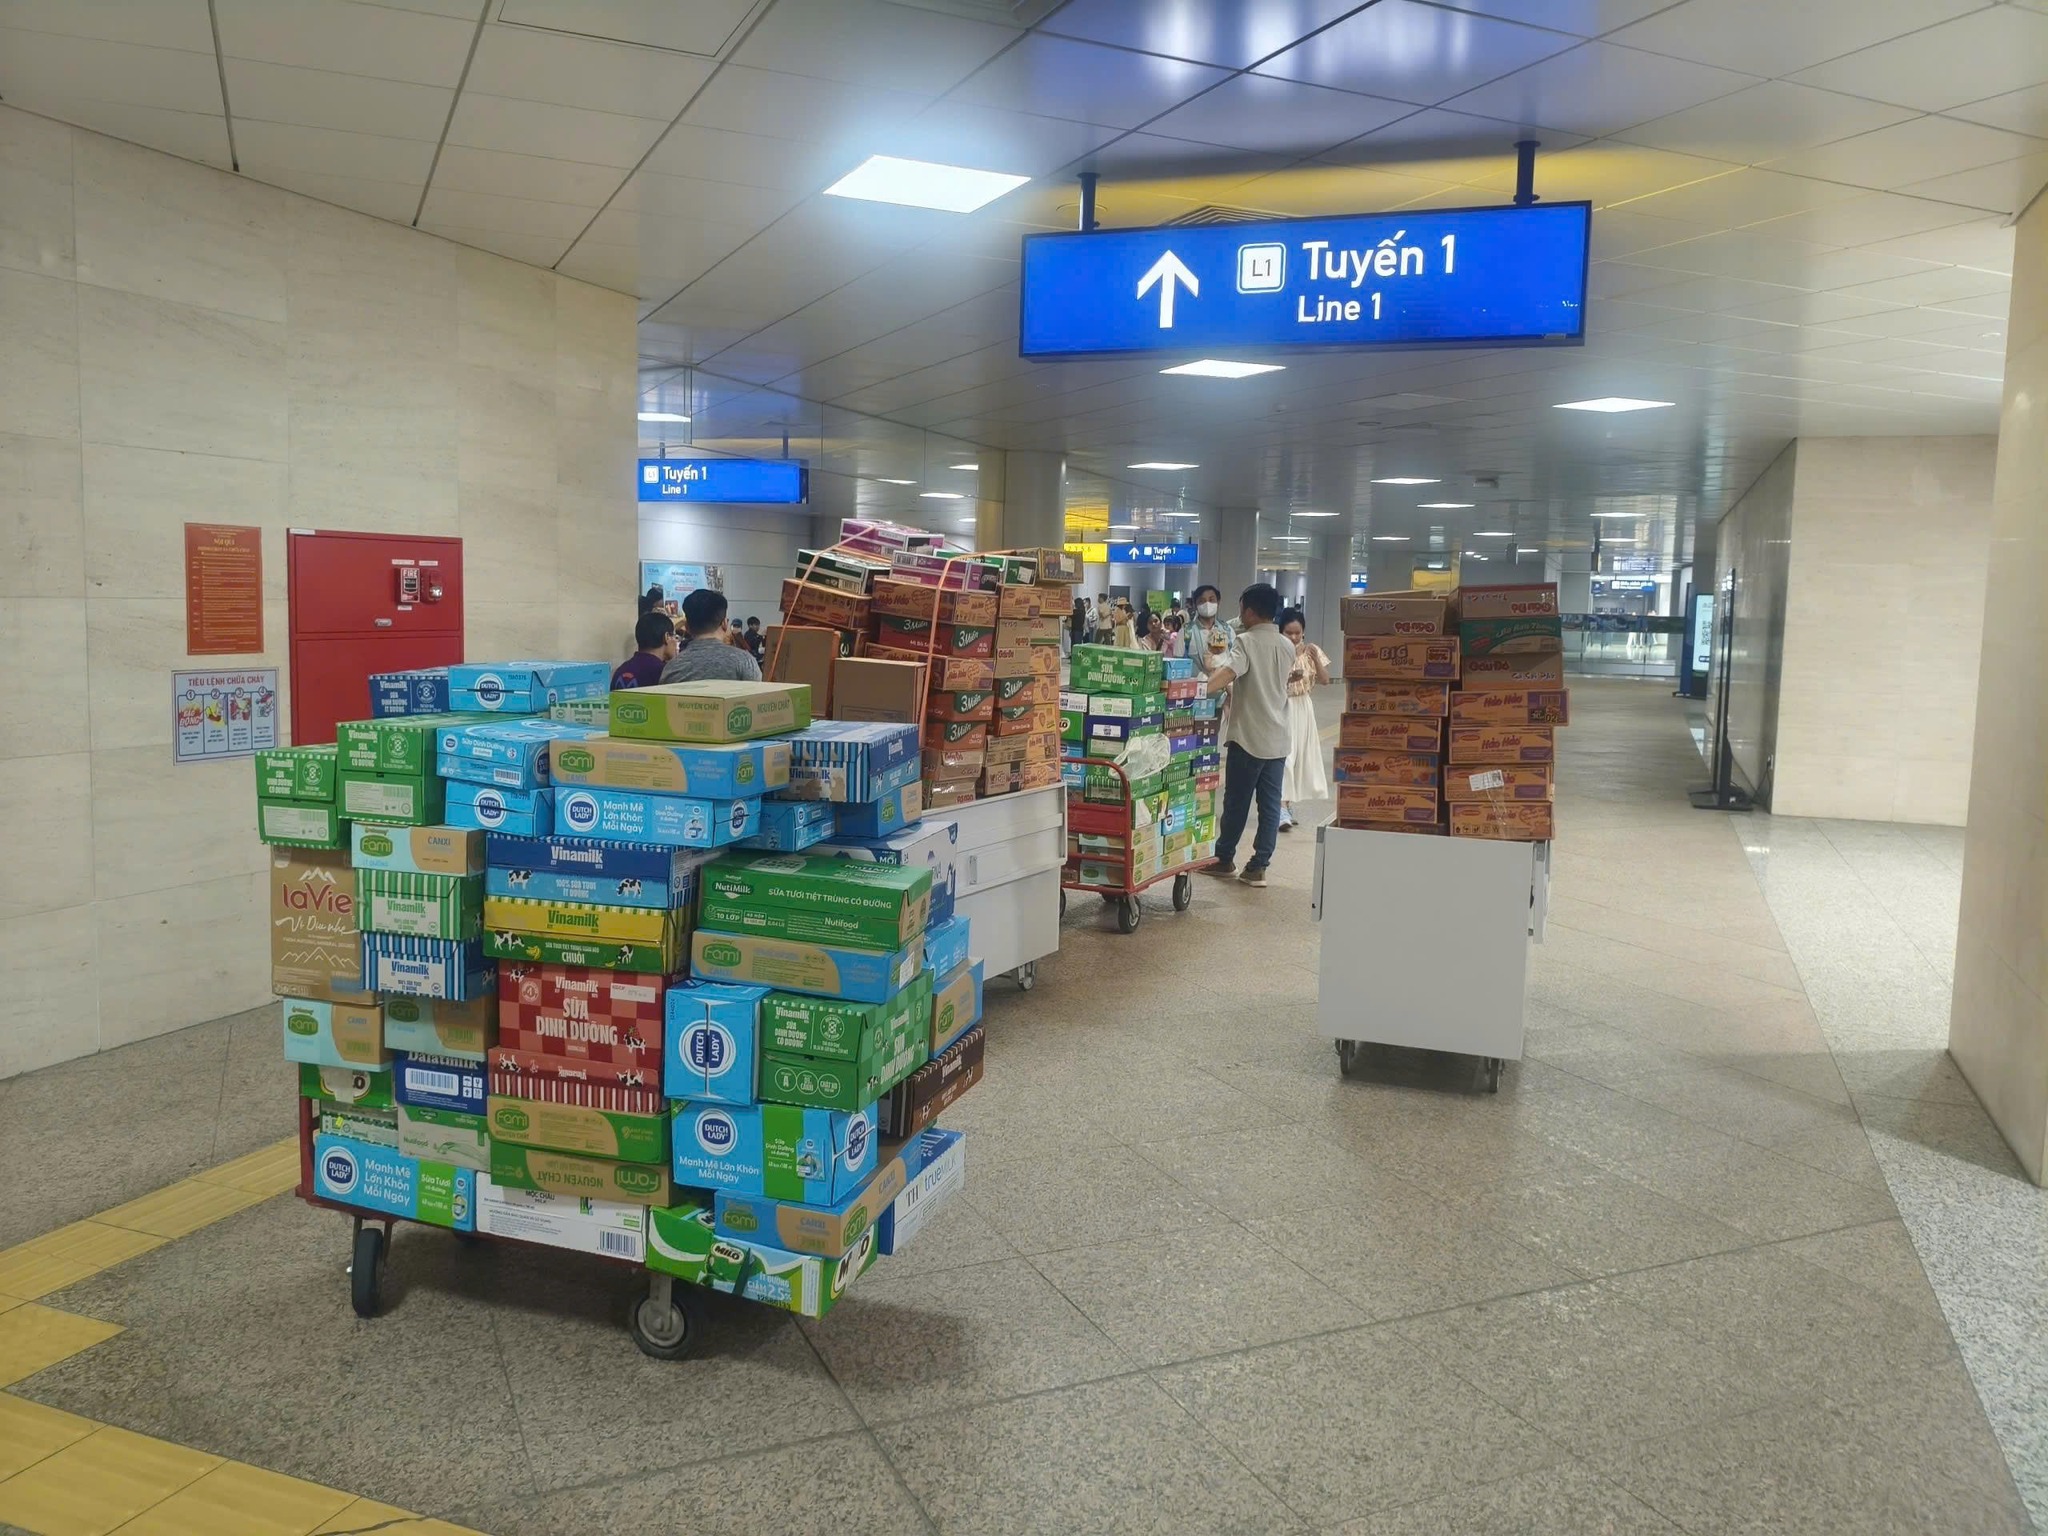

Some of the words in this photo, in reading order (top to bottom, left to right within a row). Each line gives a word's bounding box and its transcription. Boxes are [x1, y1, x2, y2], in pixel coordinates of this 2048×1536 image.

[1302, 230, 1424, 289] Tuyến
[1440, 234, 1456, 274] 1
[1251, 259, 1272, 278] L1
[1298, 293, 1360, 323] Line
[1370, 292, 1382, 320] 1
[662, 464, 698, 483] Tuyến
[701, 467, 707, 480] 1
[662, 484, 681, 495] Line
[683, 485, 687, 494] 1
[1380, 645, 1408, 661] BIG
[617, 706, 647, 720] Fami
[729, 712, 751, 730] Fami
[561, 752, 593, 769] Fami
[481, 799, 499, 808] DUTCH
[573, 806, 592, 814] DUTCH
[603, 800, 628, 811] Mạnh
[483, 808, 499, 817] LADY
[603, 811, 619, 820] Lớn
[620, 823, 644, 834] Ngày
[361, 838, 391, 853] Fami
[427, 836, 451, 846] CANXI
[551, 846, 603, 864] Vinamilk
[715, 882, 751, 894] NutiMilk
[282, 881, 353, 914] laVie
[768, 887, 785, 897] SỮA
[786, 889, 804, 899] TƯƠI
[806, 891, 822, 902] TIỆT
[823, 893, 850, 904] TRÙNG
[850, 896, 862, 906] CÓ
[387, 900, 426, 914] Vinamilk
[548, 910, 599, 927] Vinamilk
[824, 917, 859, 929] Nutifood
[703, 949, 741, 963] Fami
[391, 961, 429, 975] Vinamilk
[555, 976, 599, 993] Vinamilk
[563, 996, 589, 1020] SỮA
[775, 1006, 810, 1020] Vinamilk
[289, 1017, 317, 1034] Fami
[536, 1015, 568, 1039] DINH
[570, 1020, 618, 1046] DƯỠNG
[695, 1031, 704, 1063] DUTCH
[711, 1033, 720, 1062] LADY
[496, 1110, 528, 1127] Fami
[704, 1123, 728, 1134] DUTCH
[707, 1132, 728, 1141] LADY
[328, 1161, 351, 1173] DUTCH
[365, 1158, 394, 1174] Mạnh
[679, 1155, 704, 1168] Mạnh
[720, 1161, 735, 1172] Lớn
[736, 1164, 759, 1176] Khôn
[331, 1169, 348, 1180] LADY
[365, 1172, 382, 1184] Lớn
[384, 1176, 410, 1191] Khôn
[616, 1170, 660, 1191] Fami
[716, 1171, 740, 1184] Ngày
[384, 1189, 411, 1207] Ngày
[723, 1212, 757, 1229] Fami
[714, 1245, 741, 1262] MILO
